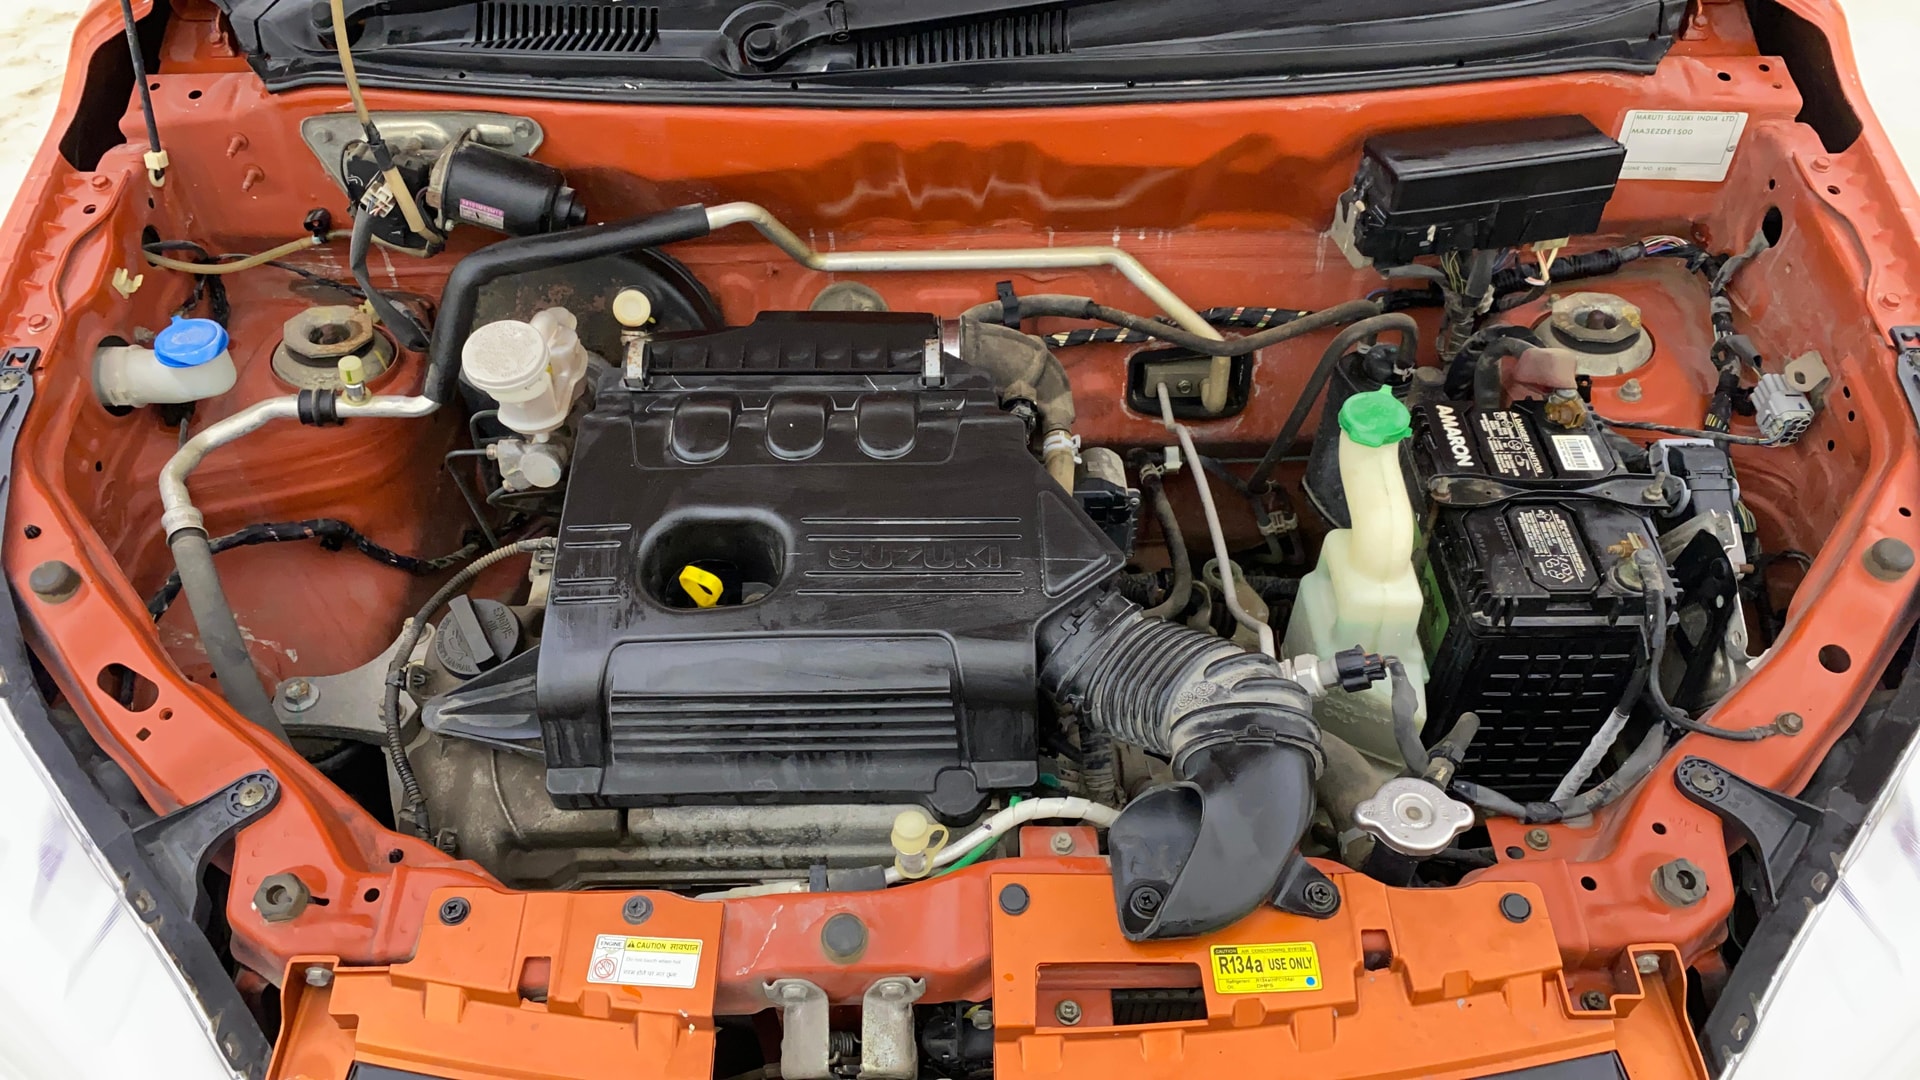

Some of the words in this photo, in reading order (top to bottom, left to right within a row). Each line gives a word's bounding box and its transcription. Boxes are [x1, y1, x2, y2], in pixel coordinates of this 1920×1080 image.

[1435, 404, 1475, 467] AMARON
[1514, 418, 1530, 442] DANGER
[1526, 446, 1545, 474] CAUTION
[828, 544, 1002, 570] SUZUKI
[636, 942, 666, 950] CAUTION
[670, 943, 698, 951] सावधान
[1218, 955, 1264, 975] R134a
[1267, 957, 1287, 971] USE
[1288, 956, 1312, 970] ONLY
